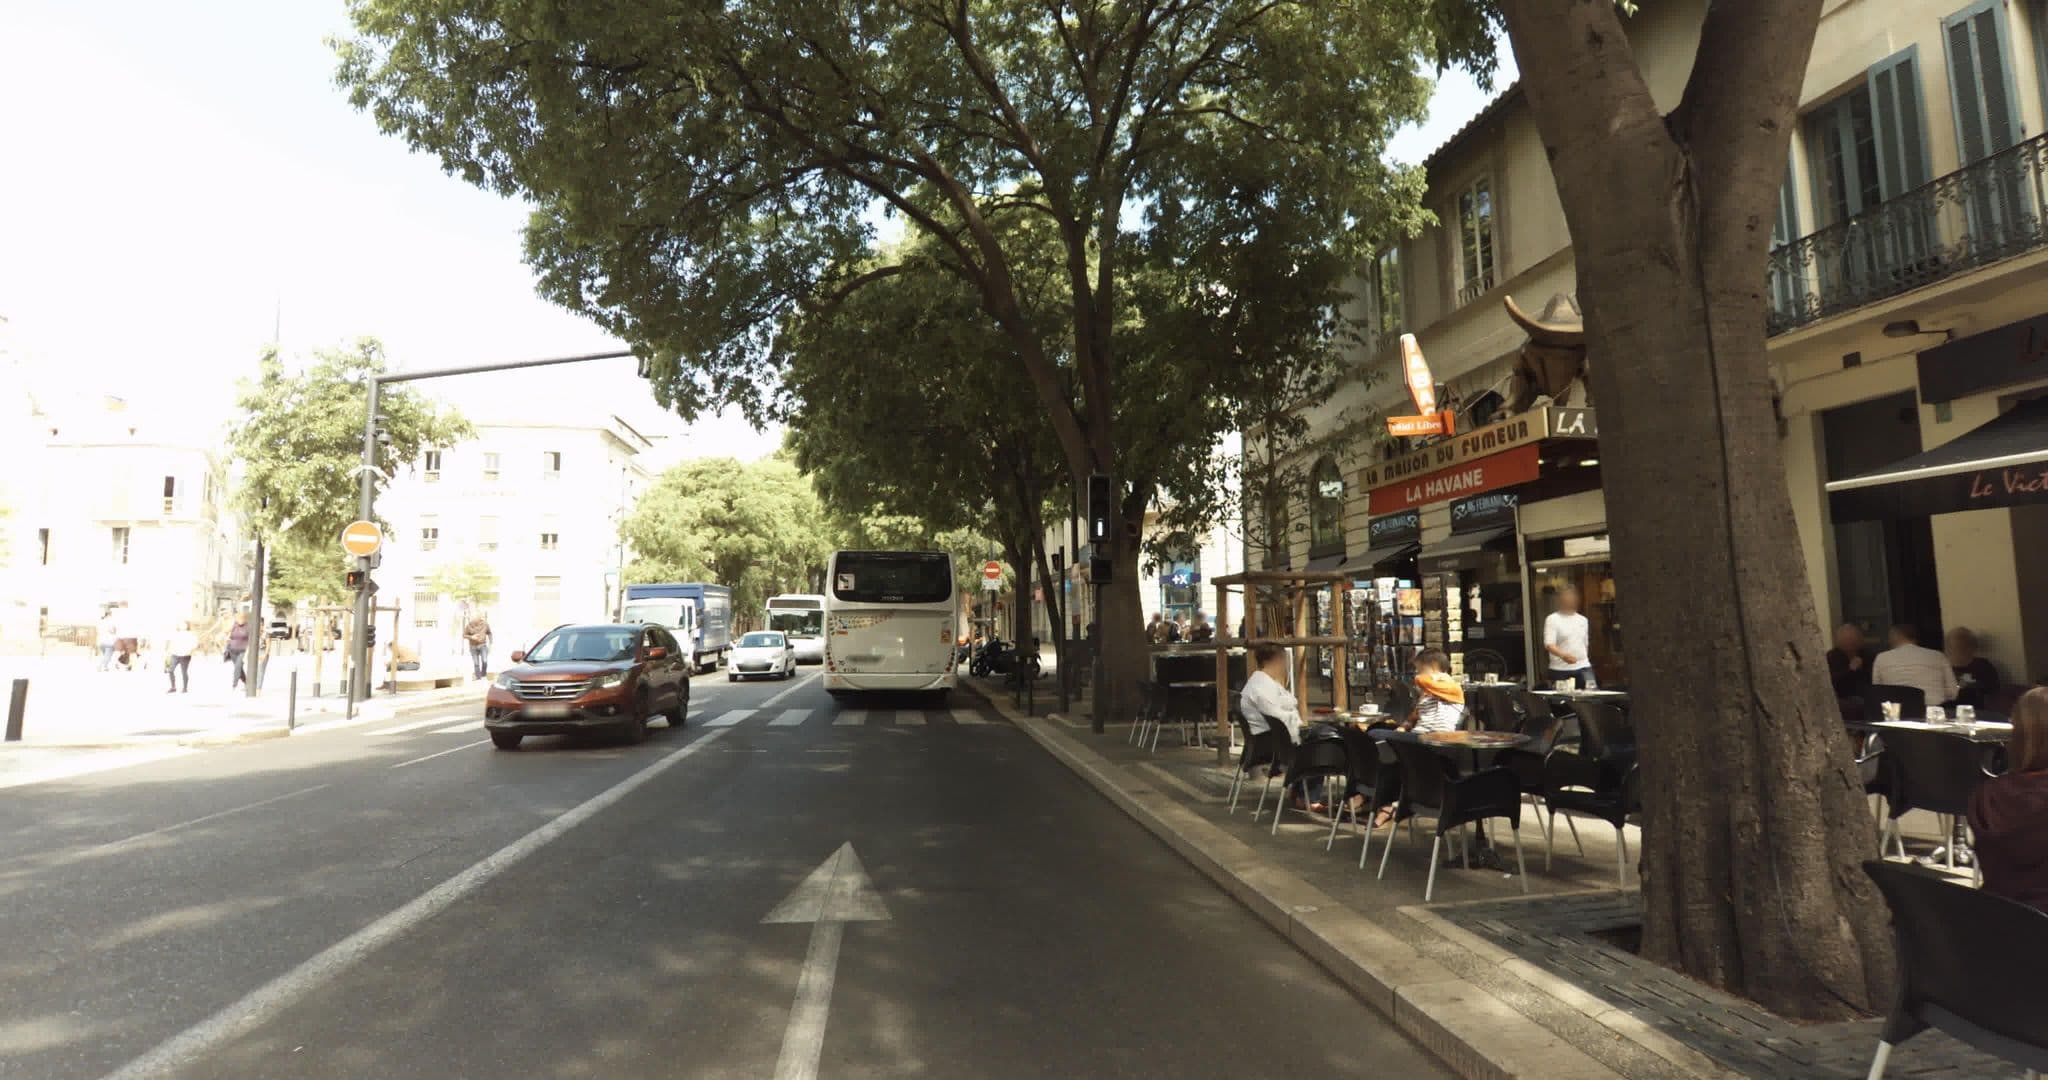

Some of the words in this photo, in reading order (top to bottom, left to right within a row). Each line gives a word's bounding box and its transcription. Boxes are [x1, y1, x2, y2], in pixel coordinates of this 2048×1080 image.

[1556, 411, 1585, 434] LA
[1384, 453, 1429, 480] MAISON
[1436, 445, 1455, 463] DU
[1461, 420, 1529, 456] FUMEUR
[1406, 486, 1422, 503] LA
[1425, 468, 1484, 497] HAVANE
[1969, 471, 1993, 499] Le
